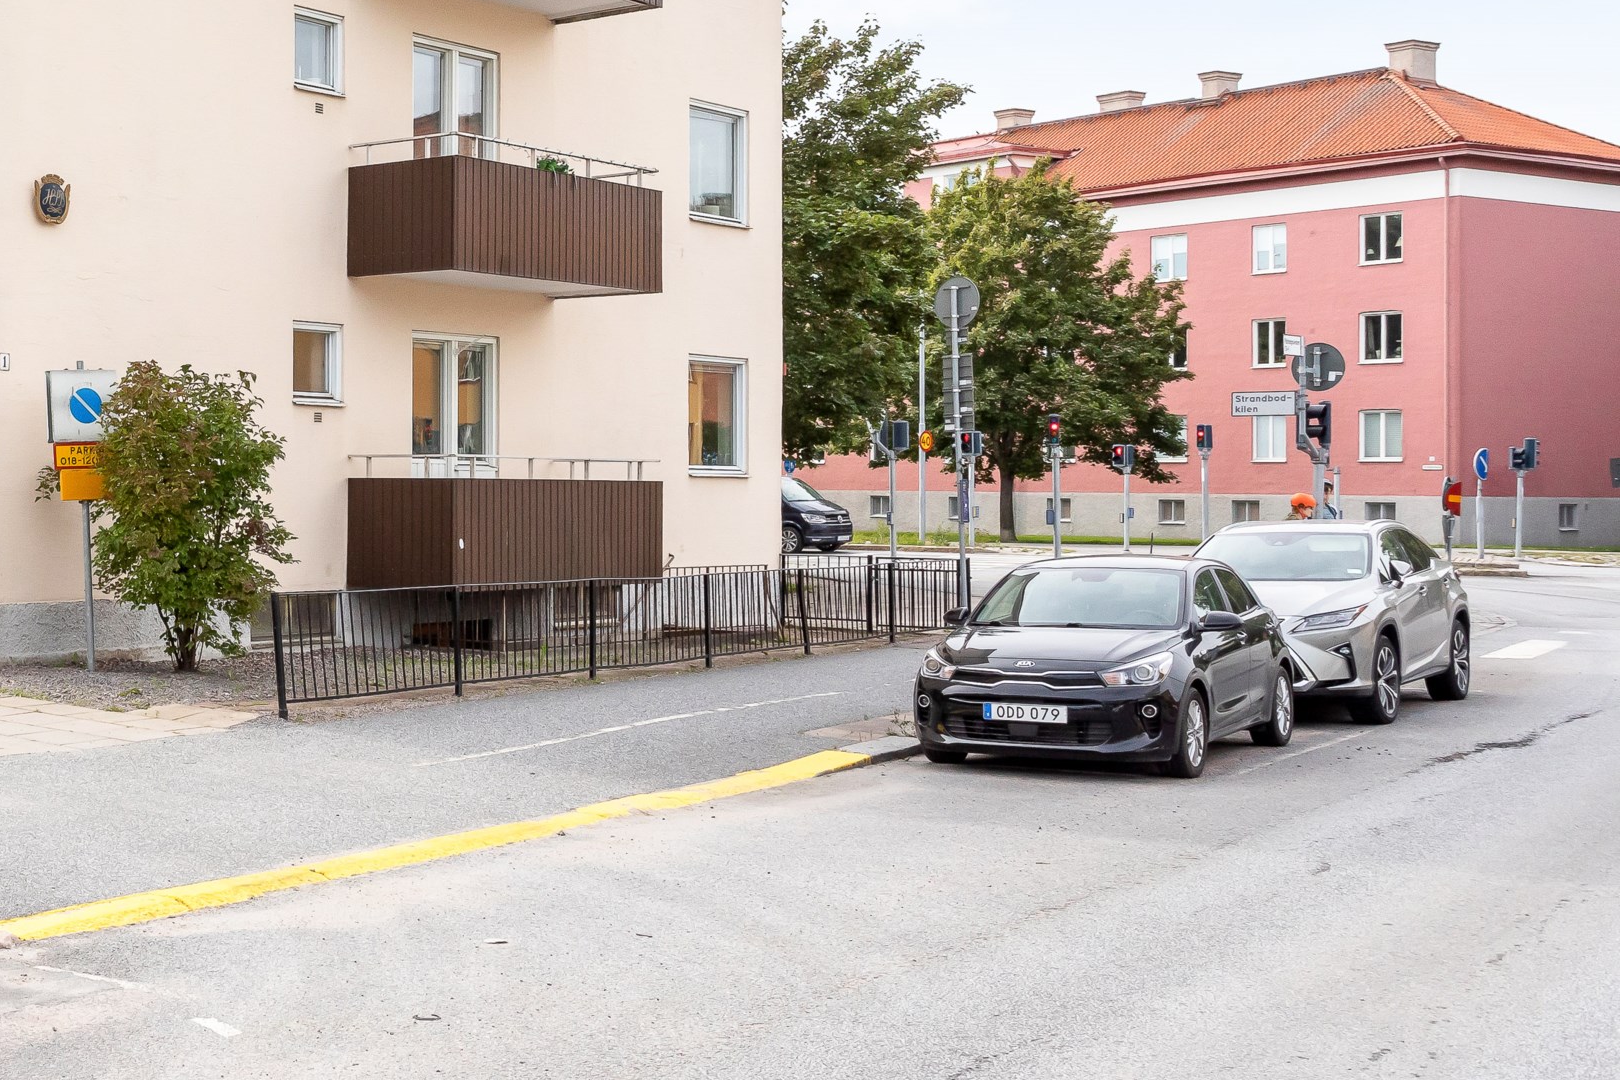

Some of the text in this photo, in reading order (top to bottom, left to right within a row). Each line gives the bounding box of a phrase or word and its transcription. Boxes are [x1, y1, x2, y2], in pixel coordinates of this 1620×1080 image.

[1235, 394, 1292, 403] Strandbod-
[1235, 405, 1258, 413] kilen
[922, 436, 930, 446] 40
[70, 446, 104, 455] PARK
[60, 456, 100, 466] 018-120
[997, 705, 1060, 721] ODD 079
